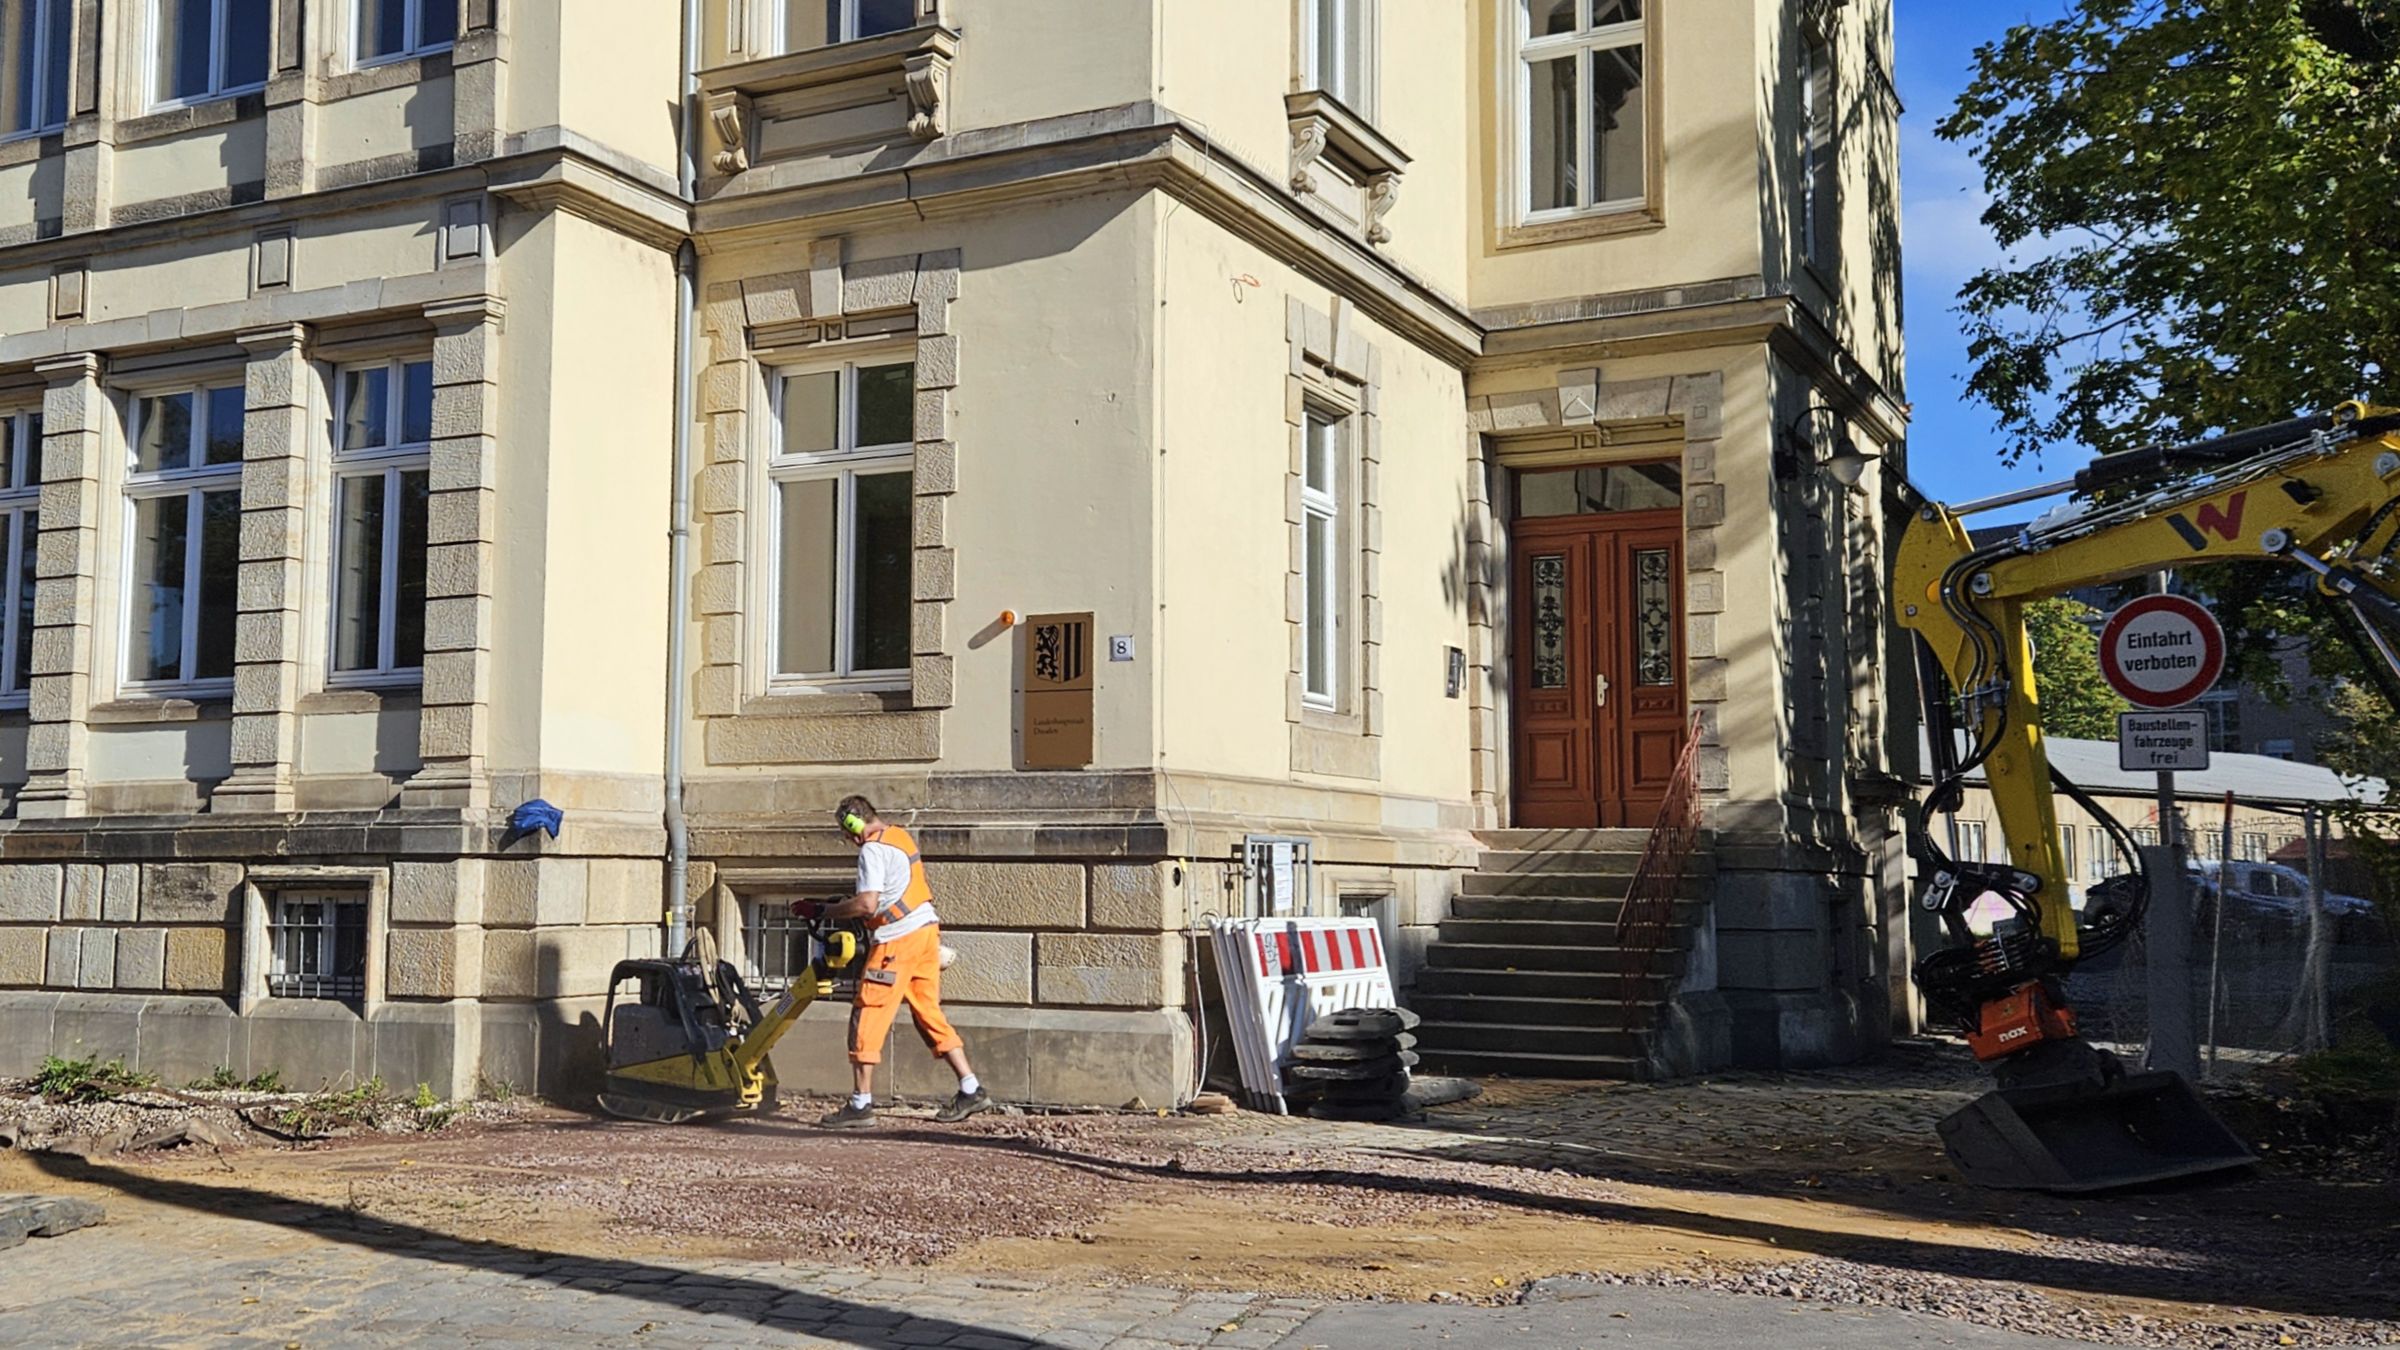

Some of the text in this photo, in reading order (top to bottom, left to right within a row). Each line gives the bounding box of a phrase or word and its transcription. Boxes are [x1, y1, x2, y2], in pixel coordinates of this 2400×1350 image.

[2127, 630, 2193, 649] Einfahrt
[1116, 640, 1127, 655] 8
[2124, 654, 2197, 672] verboten
[2128, 718, 2198, 732] Baustellen-
[2133, 734, 2194, 750] fahrzeuge
[2150, 751, 2179, 764] frei
